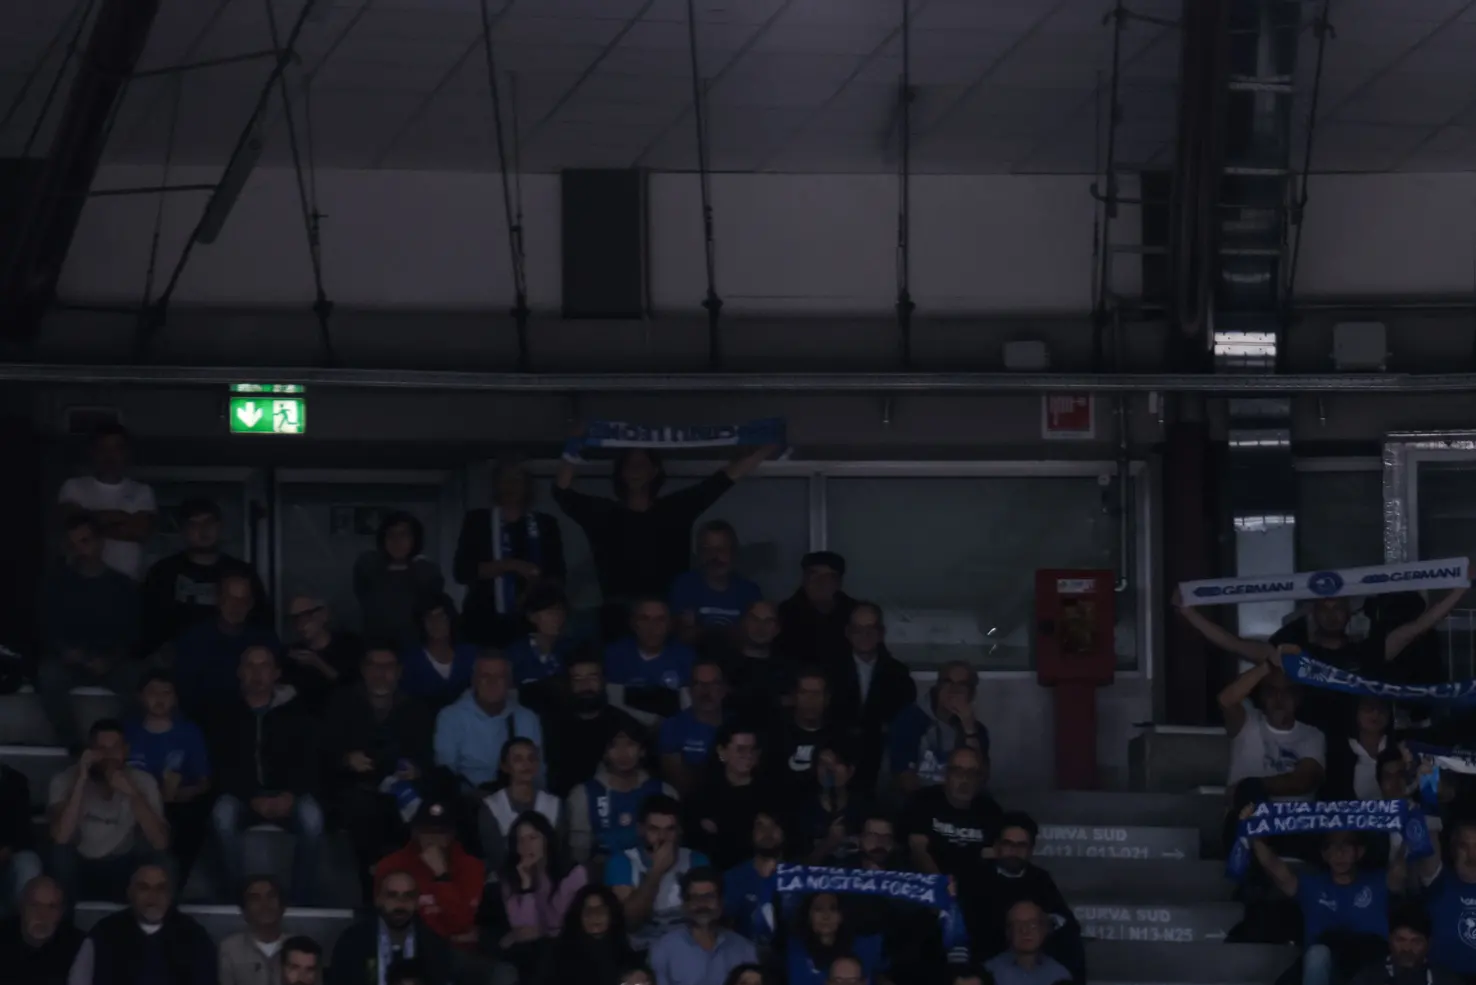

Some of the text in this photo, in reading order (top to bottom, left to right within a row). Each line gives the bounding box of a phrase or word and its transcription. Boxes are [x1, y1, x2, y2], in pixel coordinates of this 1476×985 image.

[1388, 566, 1461, 582] GERMANI
[1222, 580, 1294, 596] GERMANI
[1246, 817, 1270, 834] LA
[1274, 815, 1343, 832] NOSTRA
[1037, 827, 1128, 841] URVA SUD
[777, 876, 802, 893] LA
[1073, 907, 1171, 922] CURVA SUD
